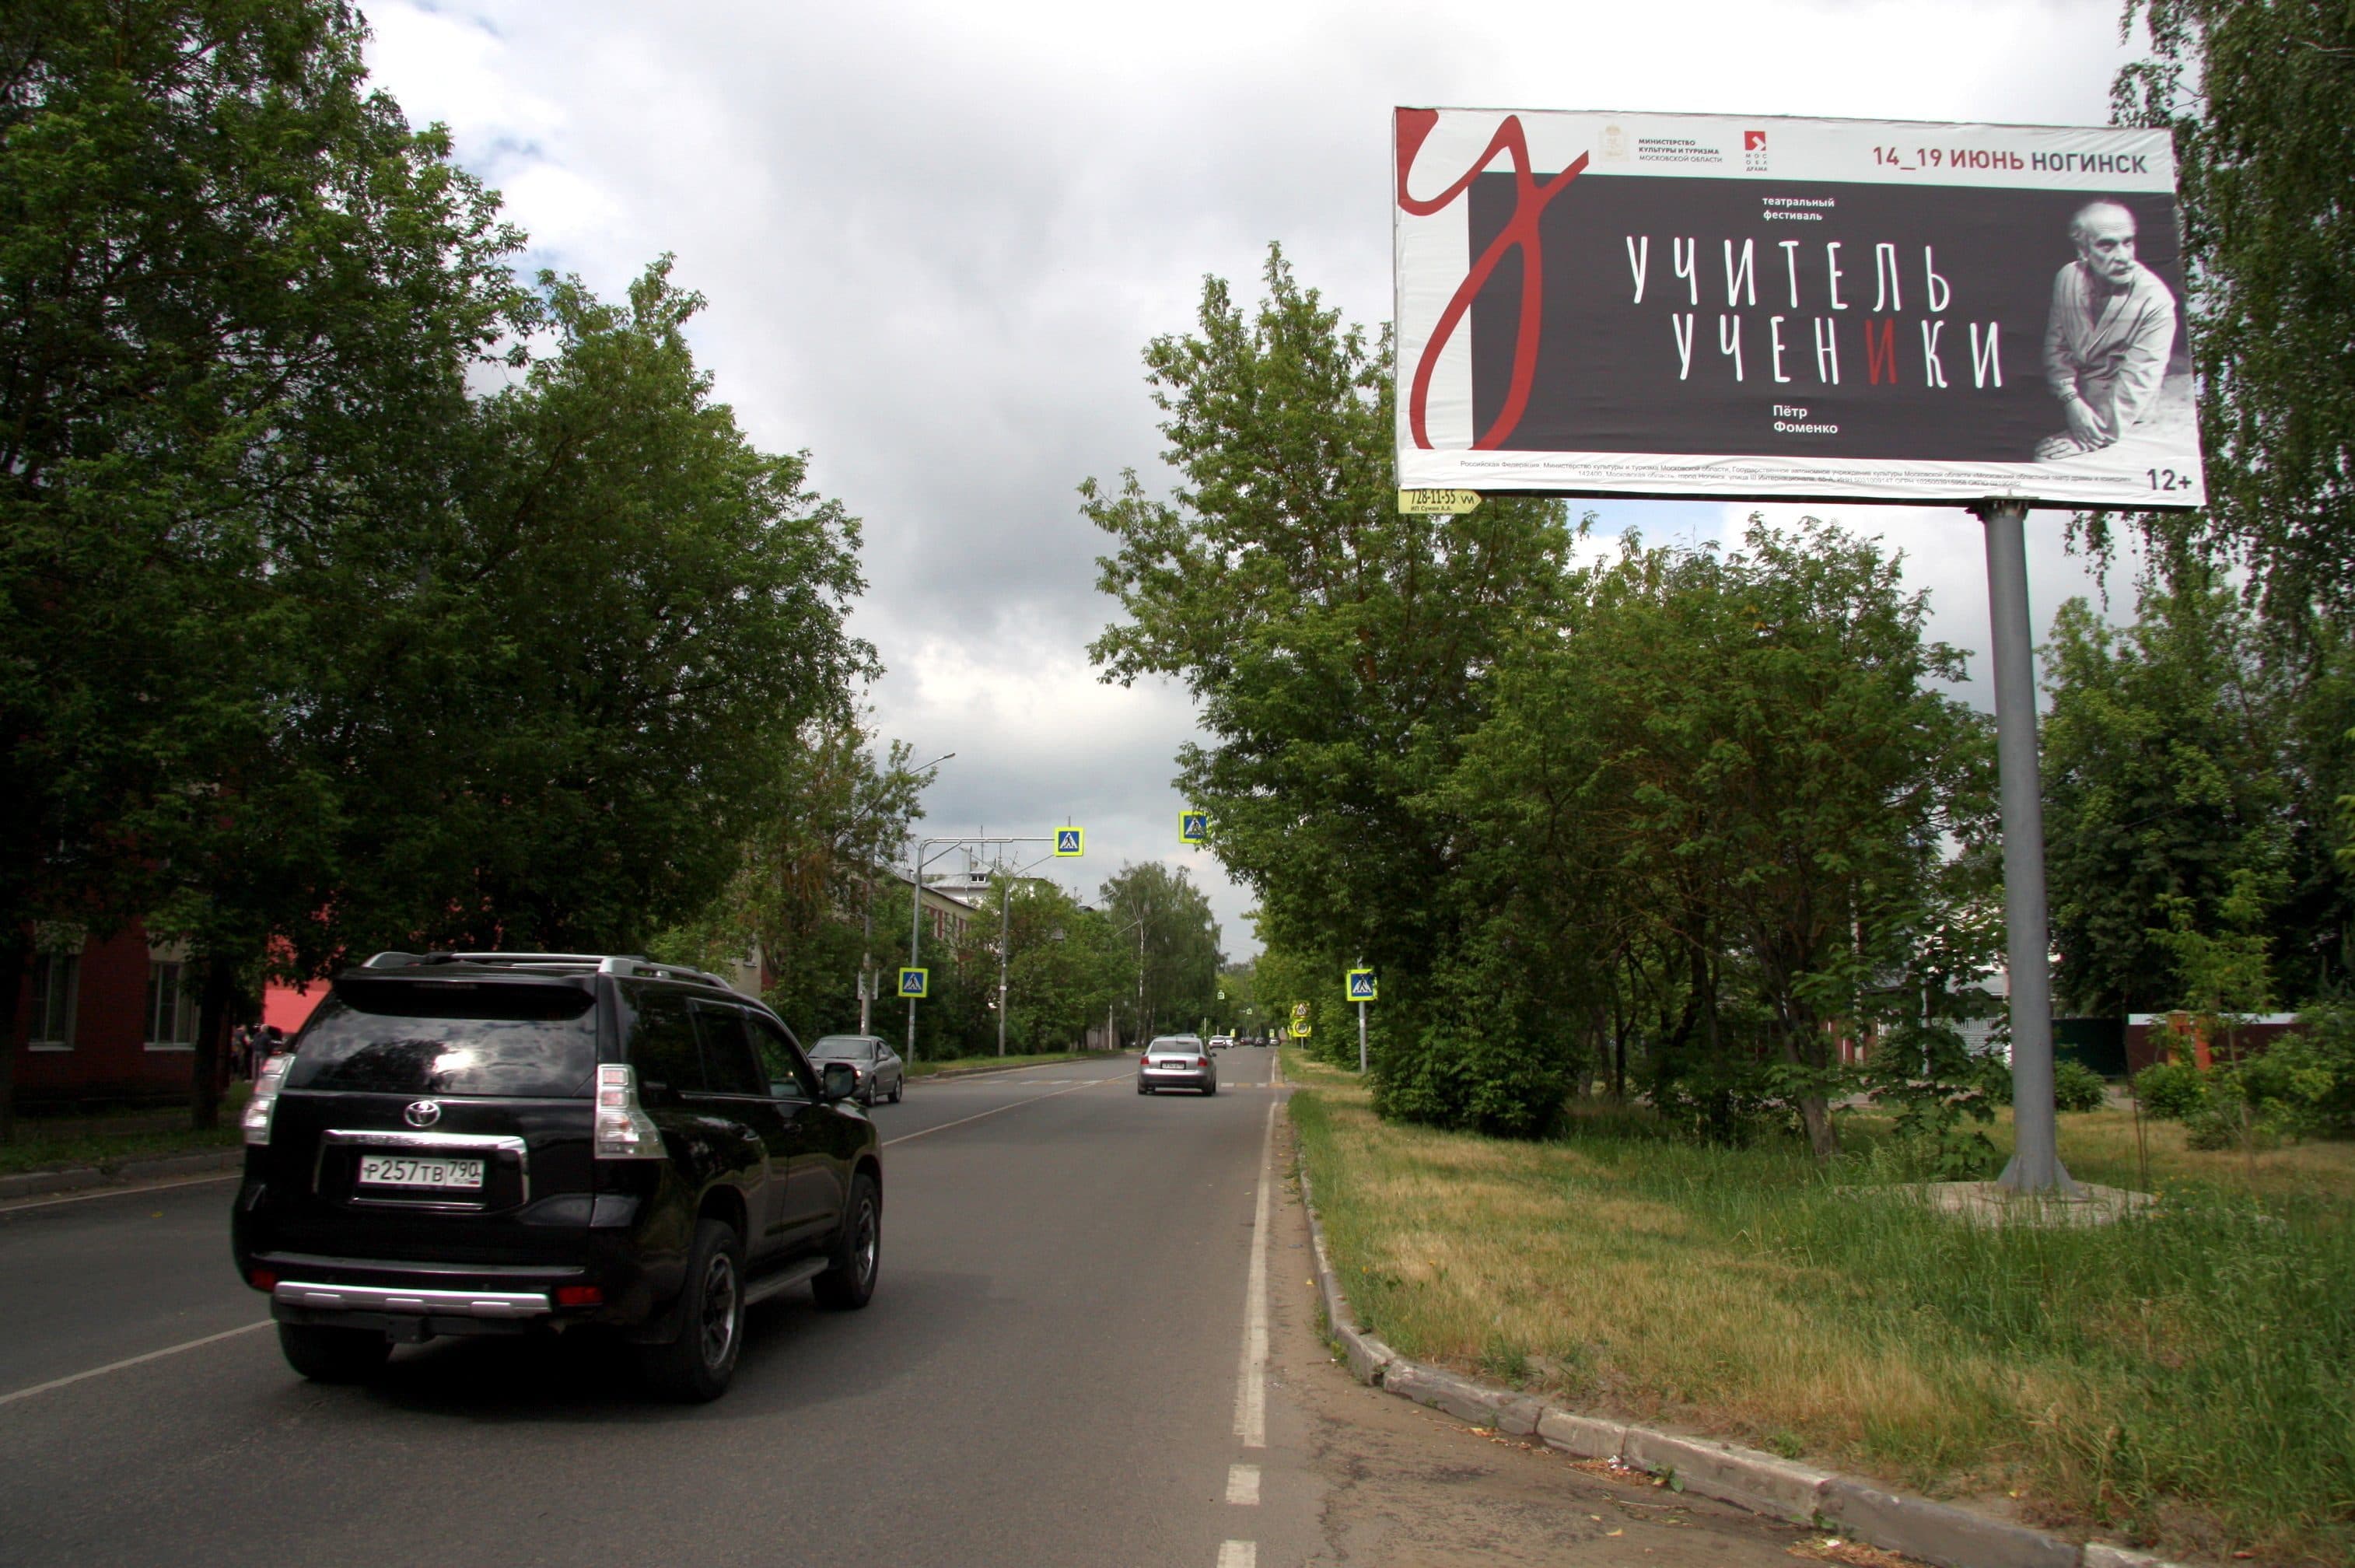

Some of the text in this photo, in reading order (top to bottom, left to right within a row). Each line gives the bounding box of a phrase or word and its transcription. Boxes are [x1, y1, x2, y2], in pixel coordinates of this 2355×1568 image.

[1873, 147, 2147, 173] 14_19 ИЮНЬ НОГИНСК
[1762, 198, 1835, 208] театральный
[1763, 209, 1823, 221] фестиваль
[1626, 236, 1950, 312] УЧИТЕЛЬ
[1672, 313, 2002, 388] УЧЕНИКИ
[1773, 404, 1807, 420] Пётр
[1774, 421, 1839, 434] Фоменко
[2147, 468, 2192, 491] 12+
